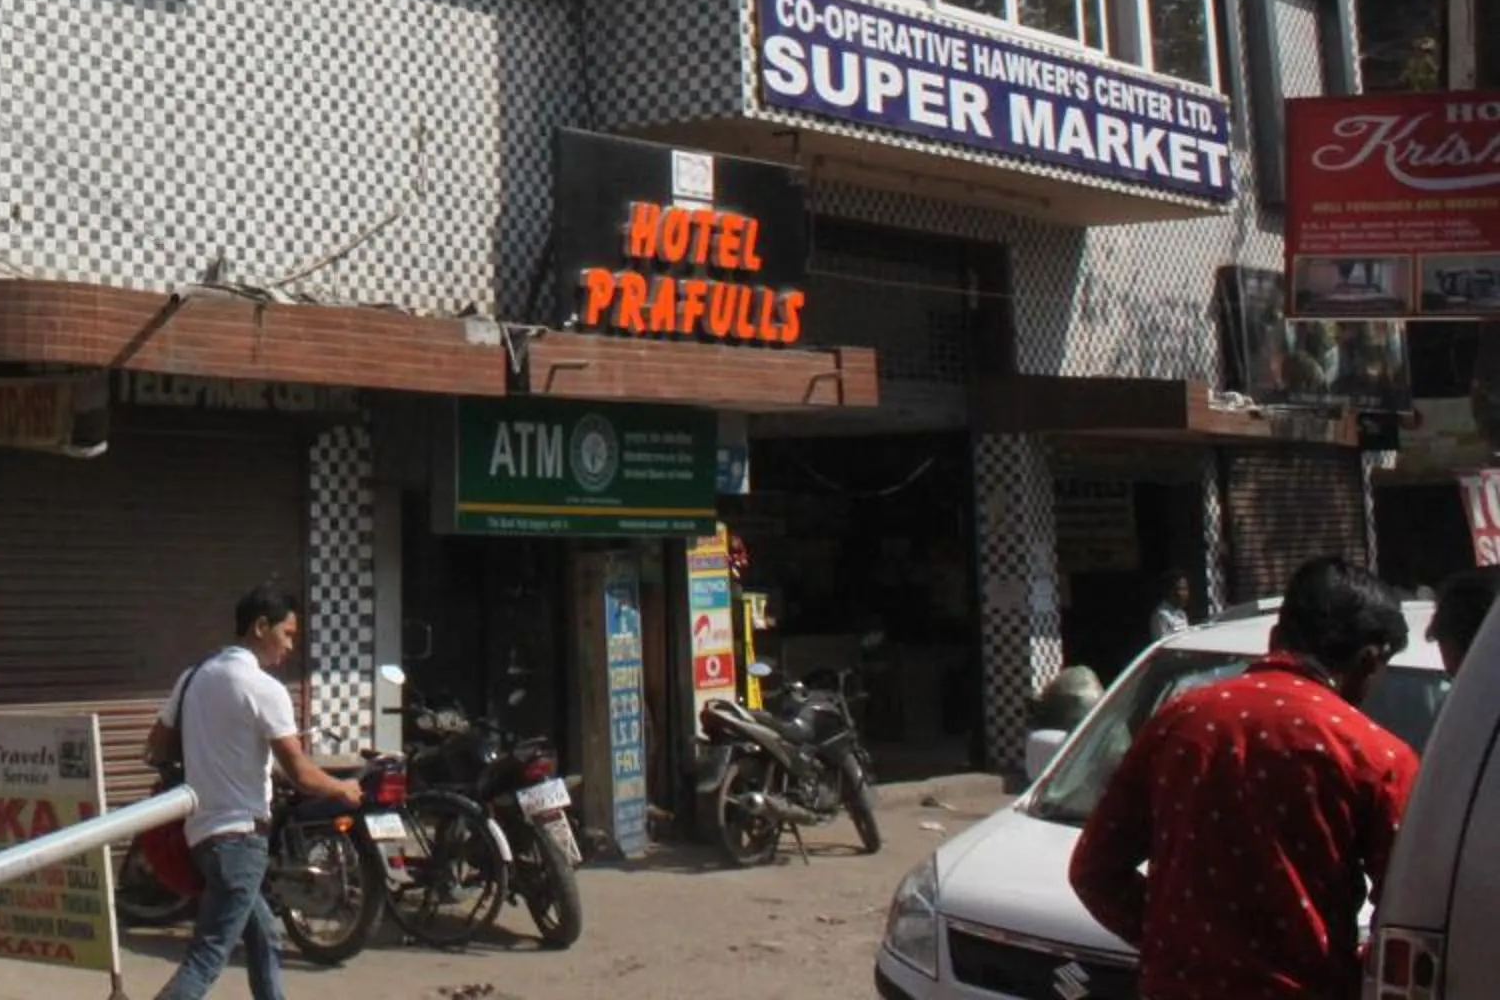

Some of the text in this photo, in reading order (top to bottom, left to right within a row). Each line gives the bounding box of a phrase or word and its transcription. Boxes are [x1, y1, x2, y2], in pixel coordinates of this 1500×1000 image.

[762, 34, 1227, 187] SUPER MARKET
[973, 44, 1089, 99] HAWKER'S
[1094, 76, 1173, 123] CENTER
[1176, 99, 1217, 135] LTD.
[627, 201, 762, 272] HOTEL
[582, 267, 804, 343] PRAFULLS
[489, 421, 563, 480] ATM
